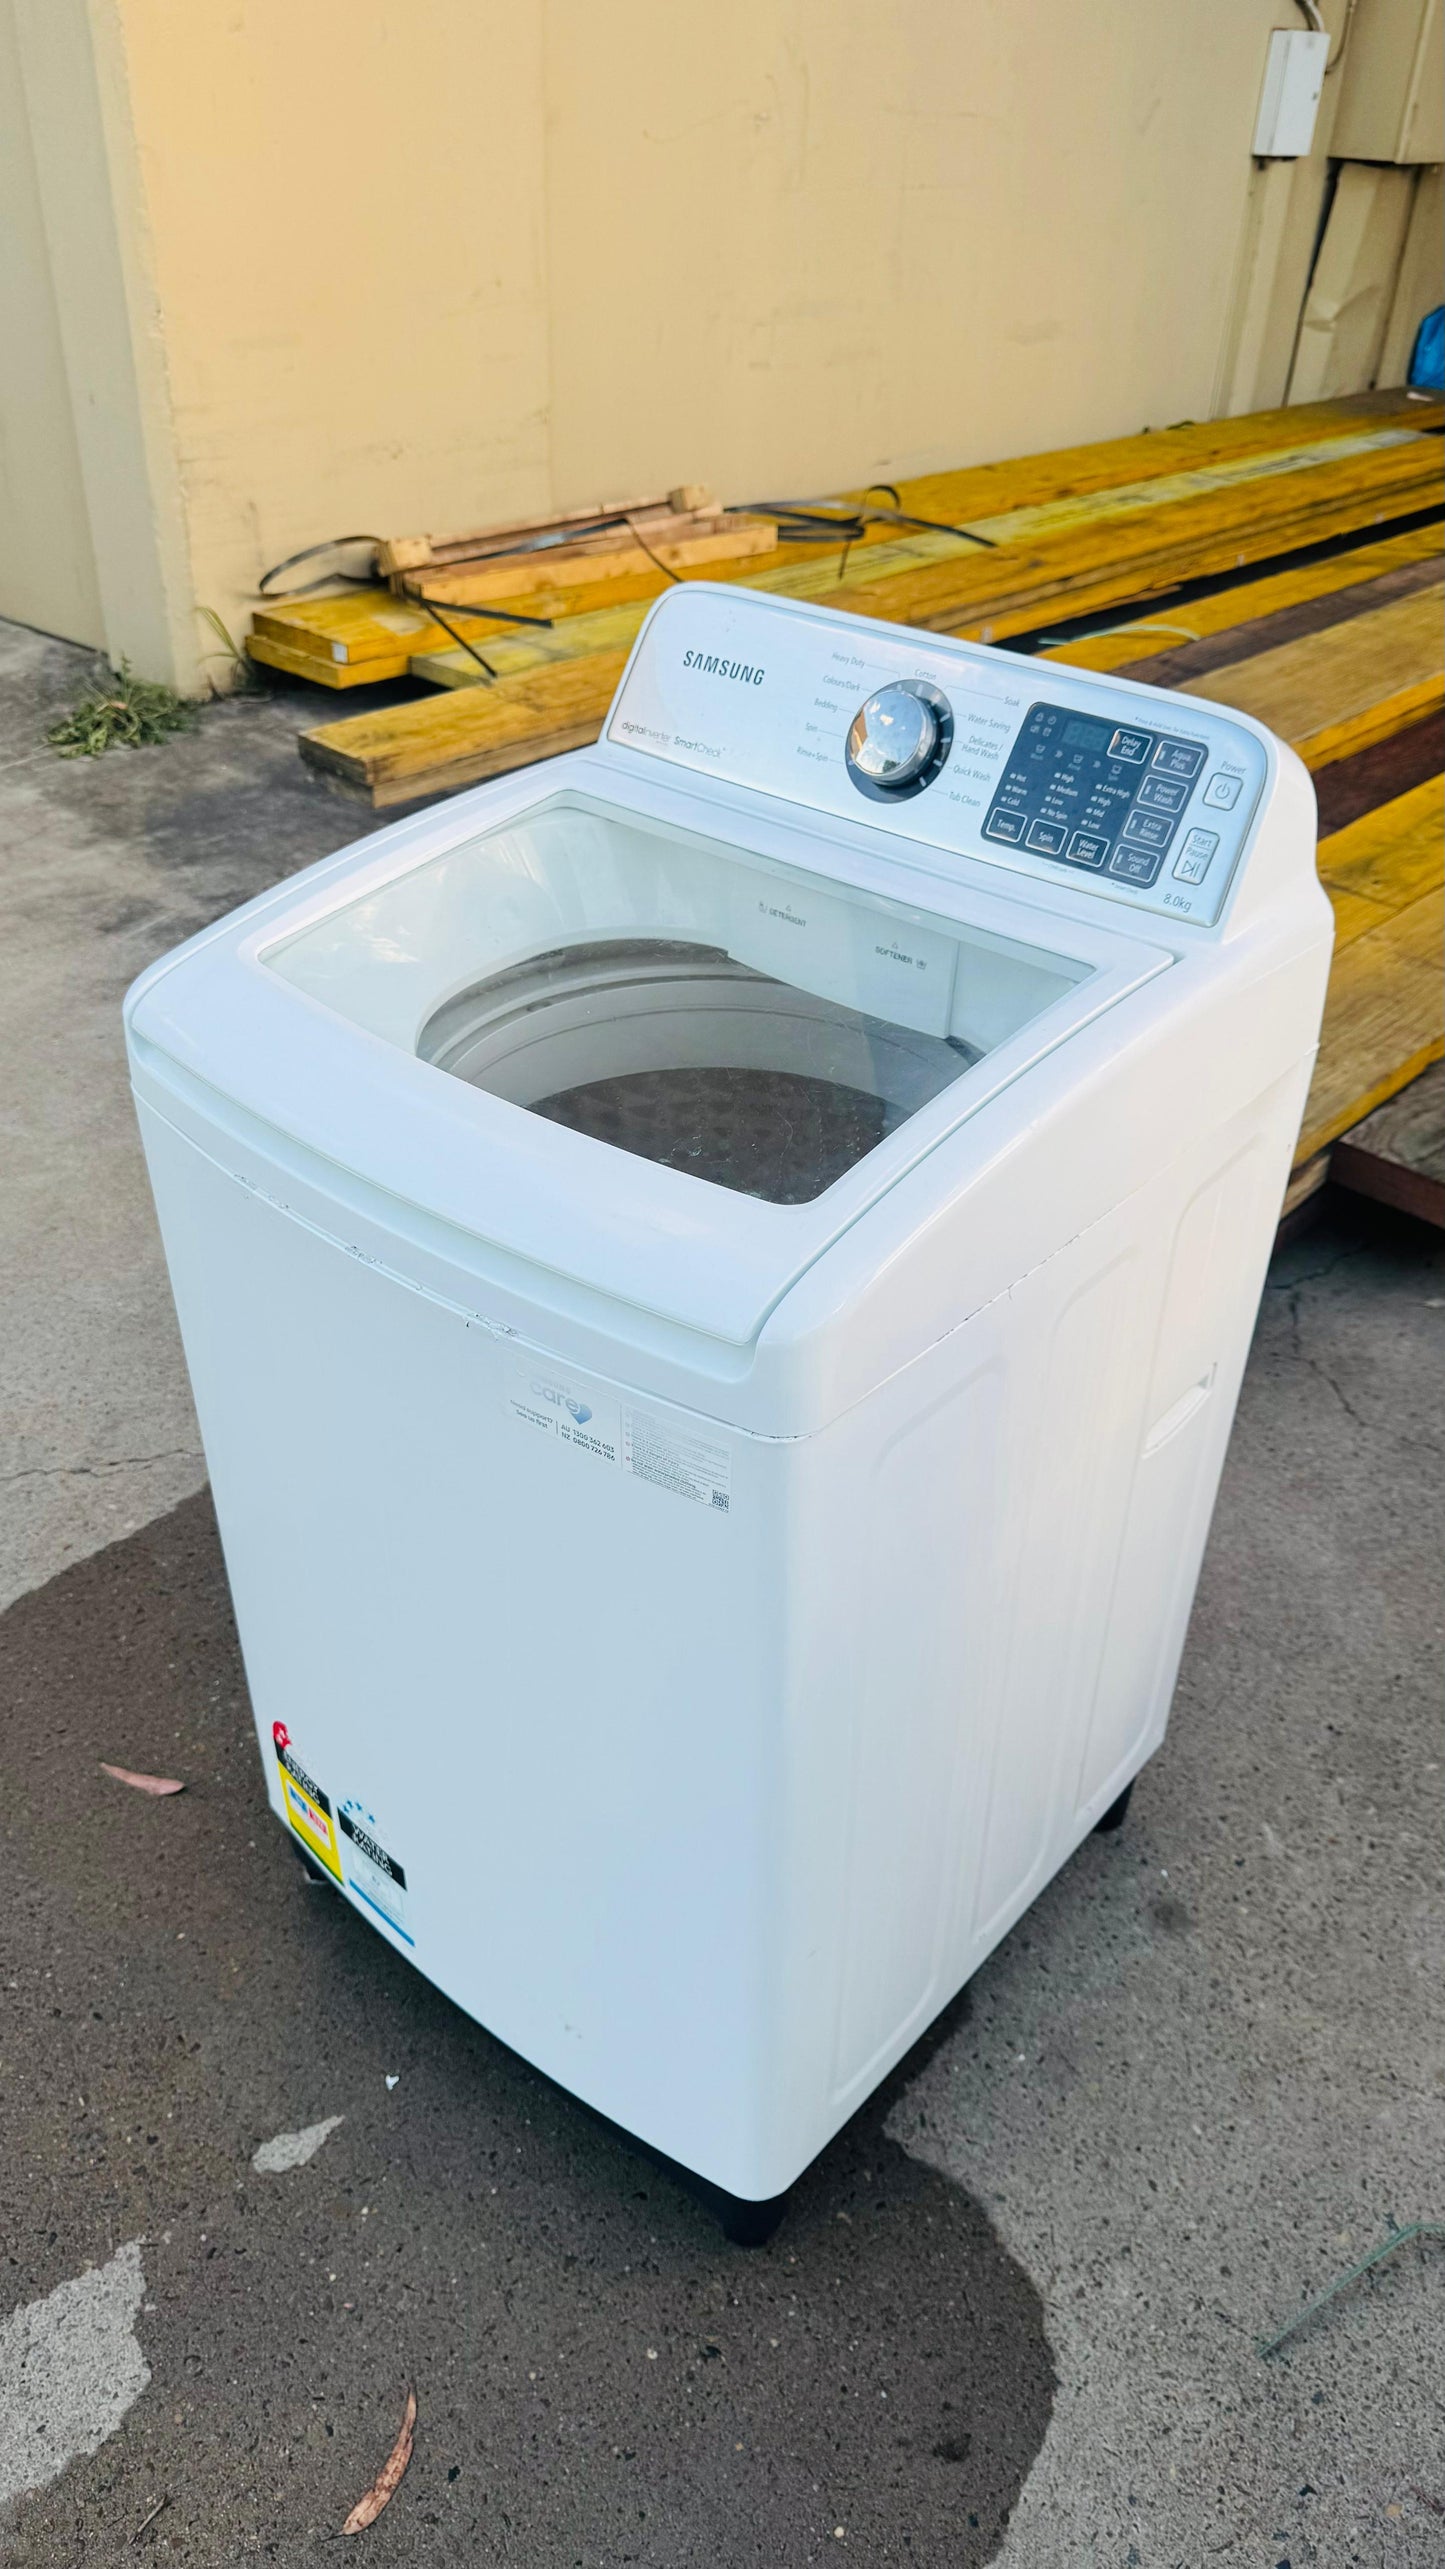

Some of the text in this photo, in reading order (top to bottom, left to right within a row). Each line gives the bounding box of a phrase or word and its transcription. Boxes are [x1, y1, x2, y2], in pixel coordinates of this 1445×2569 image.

[832, 652, 866, 669] Heavy Duty
[683, 650, 765, 686] SAMSUNG
[914, 668, 937, 680] Cotton
[814, 698, 839, 713] Bedding
[1004, 696, 1020, 707] Soak
[805, 722, 818, 732] Spin
[967, 713, 1011, 734] Water Saving
[969, 736, 999, 751] Delicates
[1121, 736, 1142, 750] Delay
[962, 744, 1000, 761] Hand Wash
[1120, 745, 1136, 757] End
[1171, 749, 1193, 763] Aqua
[1169, 758, 1186, 770] Plus
[1220, 760, 1247, 775] Power
[953, 765, 992, 782] Quick Wash
[1016, 774, 1027, 783] Hot
[1061, 773, 1075, 783] High
[1011, 785, 1028, 796] Warm
[1056, 785, 1079, 797] Medium
[1102, 785, 1131, 800] Extra High
[1156, 784, 1180, 798] Power
[949, 791, 981, 808] Tub Clean
[1007, 797, 1021, 807] Cold
[1052, 797, 1064, 806] Low
[1097, 796, 1112, 807] High
[1153, 792, 1173, 806] Wash
[1047, 808, 1068, 821] No Spin
[1093, 808, 1105, 818] Mid
[997, 819, 1016, 832] Temp.
[1087, 819, 1101, 830] Low
[1142, 819, 1162, 832] Extra
[1038, 831, 1054, 844] Spin
[1138, 828, 1159, 841] Rinse
[1192, 834, 1213, 848] Start
[1079, 838, 1099, 851] Water
[1076, 846, 1095, 860] Level
[1127, 852, 1150, 867] Sound
[1186, 847, 1209, 861] Pause
[1129, 863, 1142, 875] Off
[1163, 892, 1192, 913] 8.0kg
[769, 908, 807, 927] DETERGENT
[875, 945, 913, 965] SOFTENER
[530, 1379, 580, 1413] care
[561, 1424, 570, 1433] AU
[573, 1429, 589, 1441] 1300
[561, 1432, 571, 1441] NZ
[573, 1437, 590, 1450] 0800
